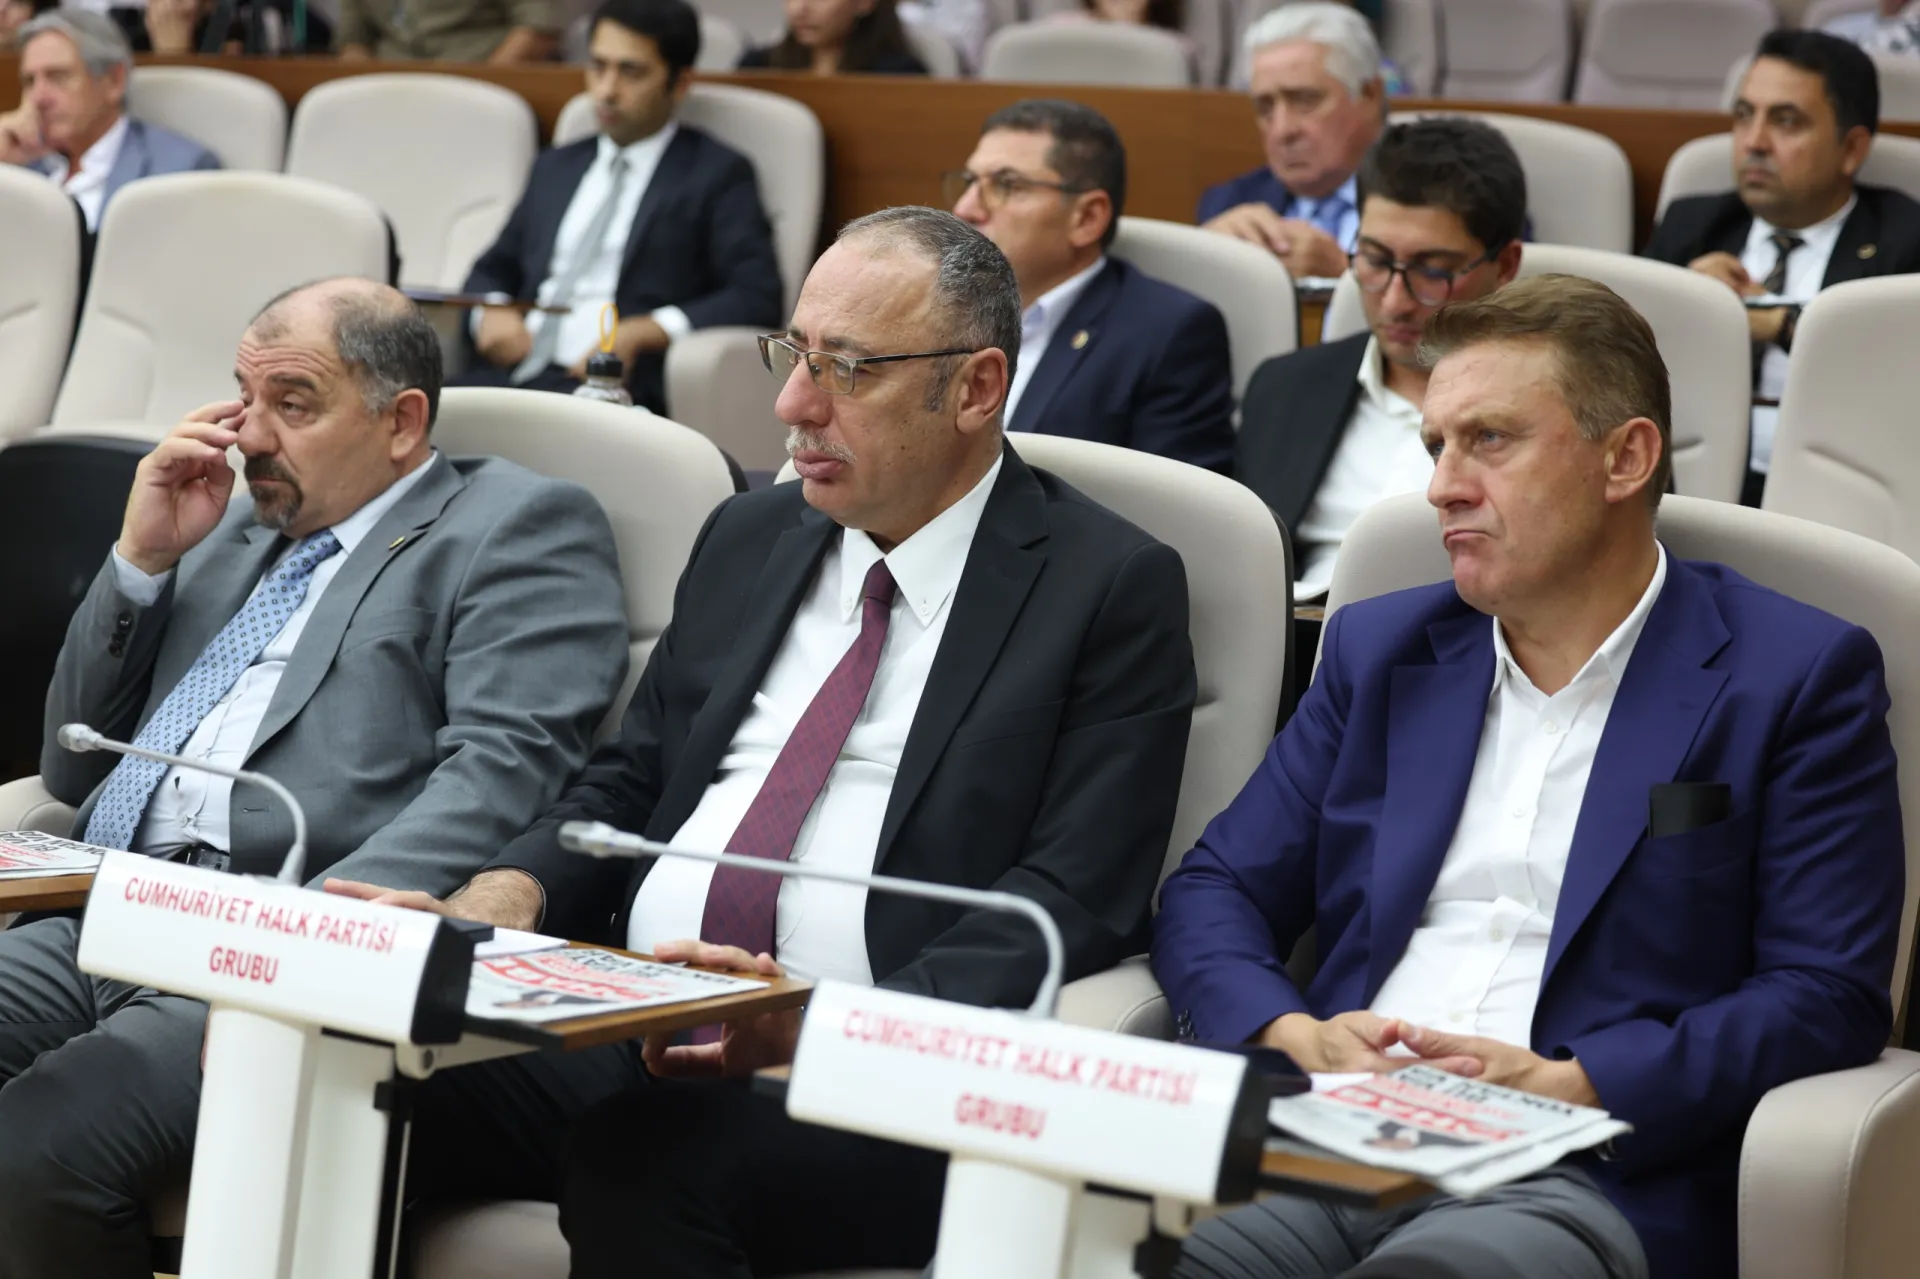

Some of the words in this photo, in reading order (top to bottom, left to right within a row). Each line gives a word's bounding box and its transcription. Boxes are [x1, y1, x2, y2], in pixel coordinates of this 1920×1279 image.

[124, 876, 254, 926] CUMHURİYET
[255, 902, 308, 938] HALK
[315, 914, 400, 954] PARTİSİ
[208, 945, 280, 985] GRUBU
[843, 1009, 1009, 1069] CUMHURİYET
[1012, 1042, 1084, 1086] HALK
[1089, 1059, 1198, 1106] PARTİSİ
[954, 1092, 1046, 1140] GRUBU
